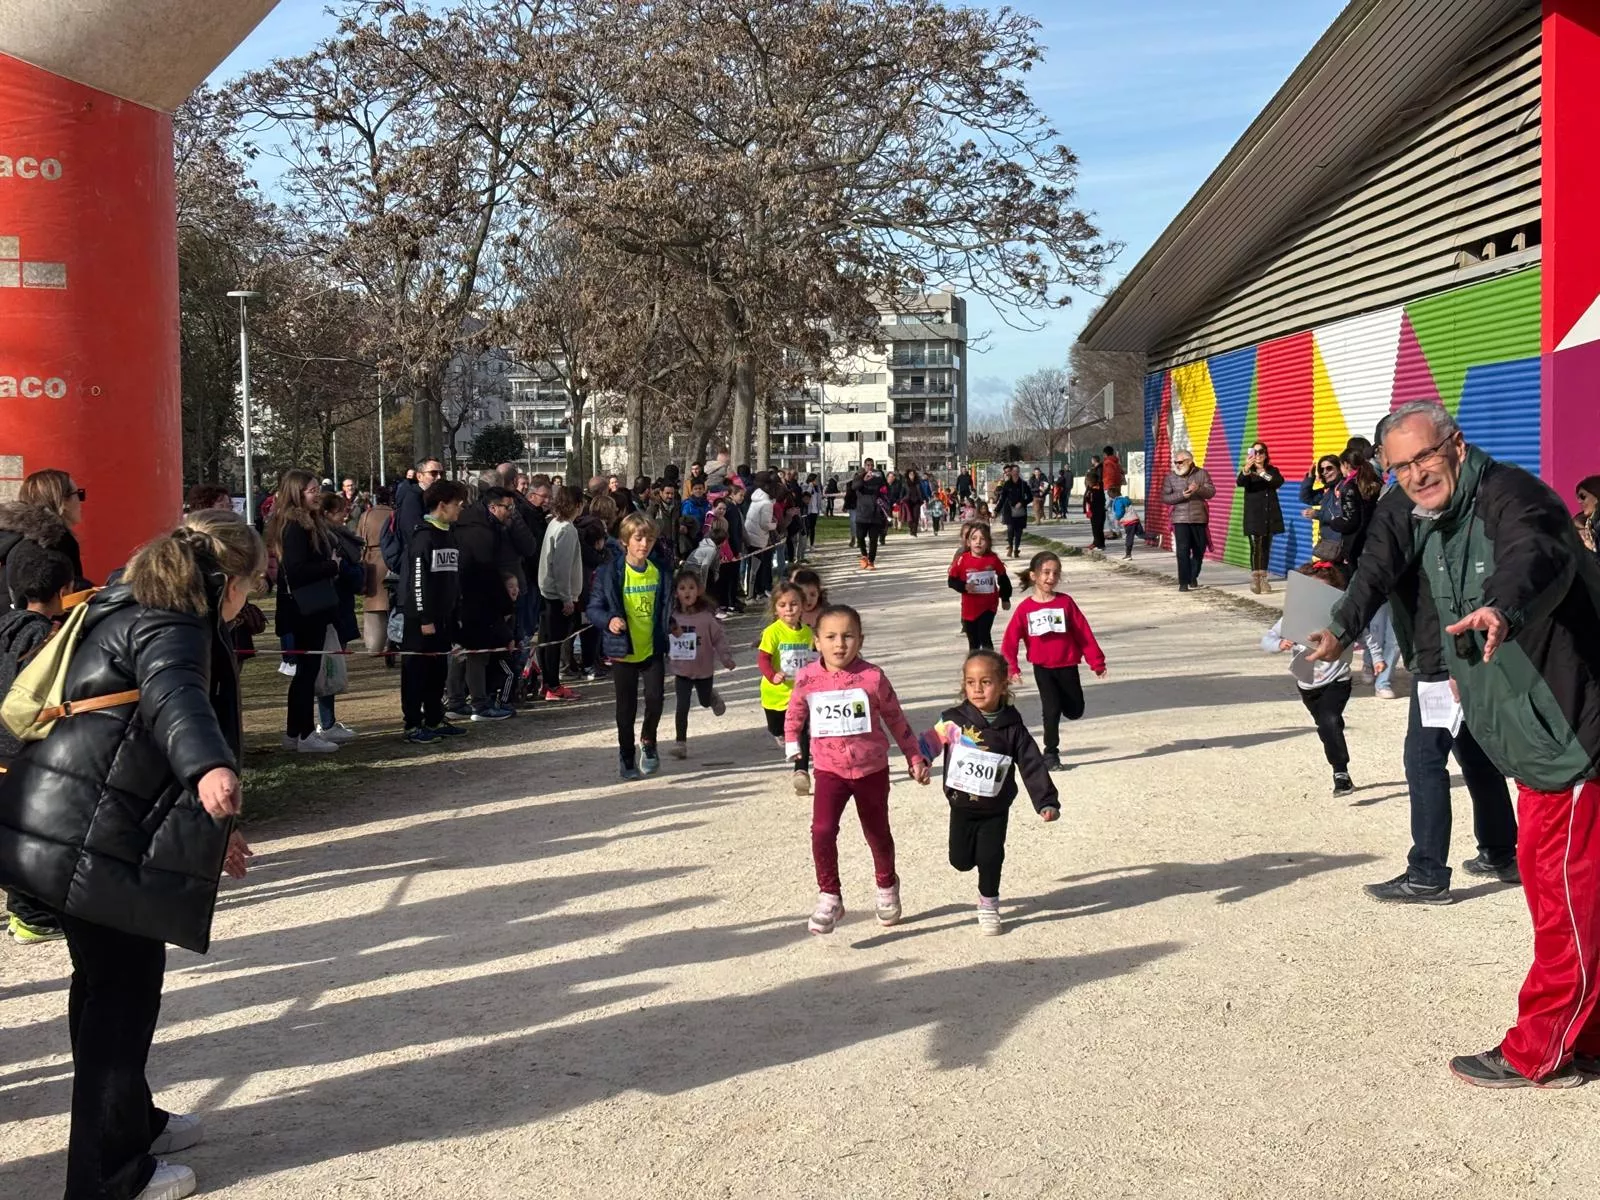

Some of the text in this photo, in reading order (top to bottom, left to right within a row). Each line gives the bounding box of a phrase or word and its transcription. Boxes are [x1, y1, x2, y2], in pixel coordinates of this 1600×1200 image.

[0, 375, 67, 399] aco
[436, 551, 459, 564] NAS
[824, 702, 852, 719] 256
[964, 761, 994, 780] 380
